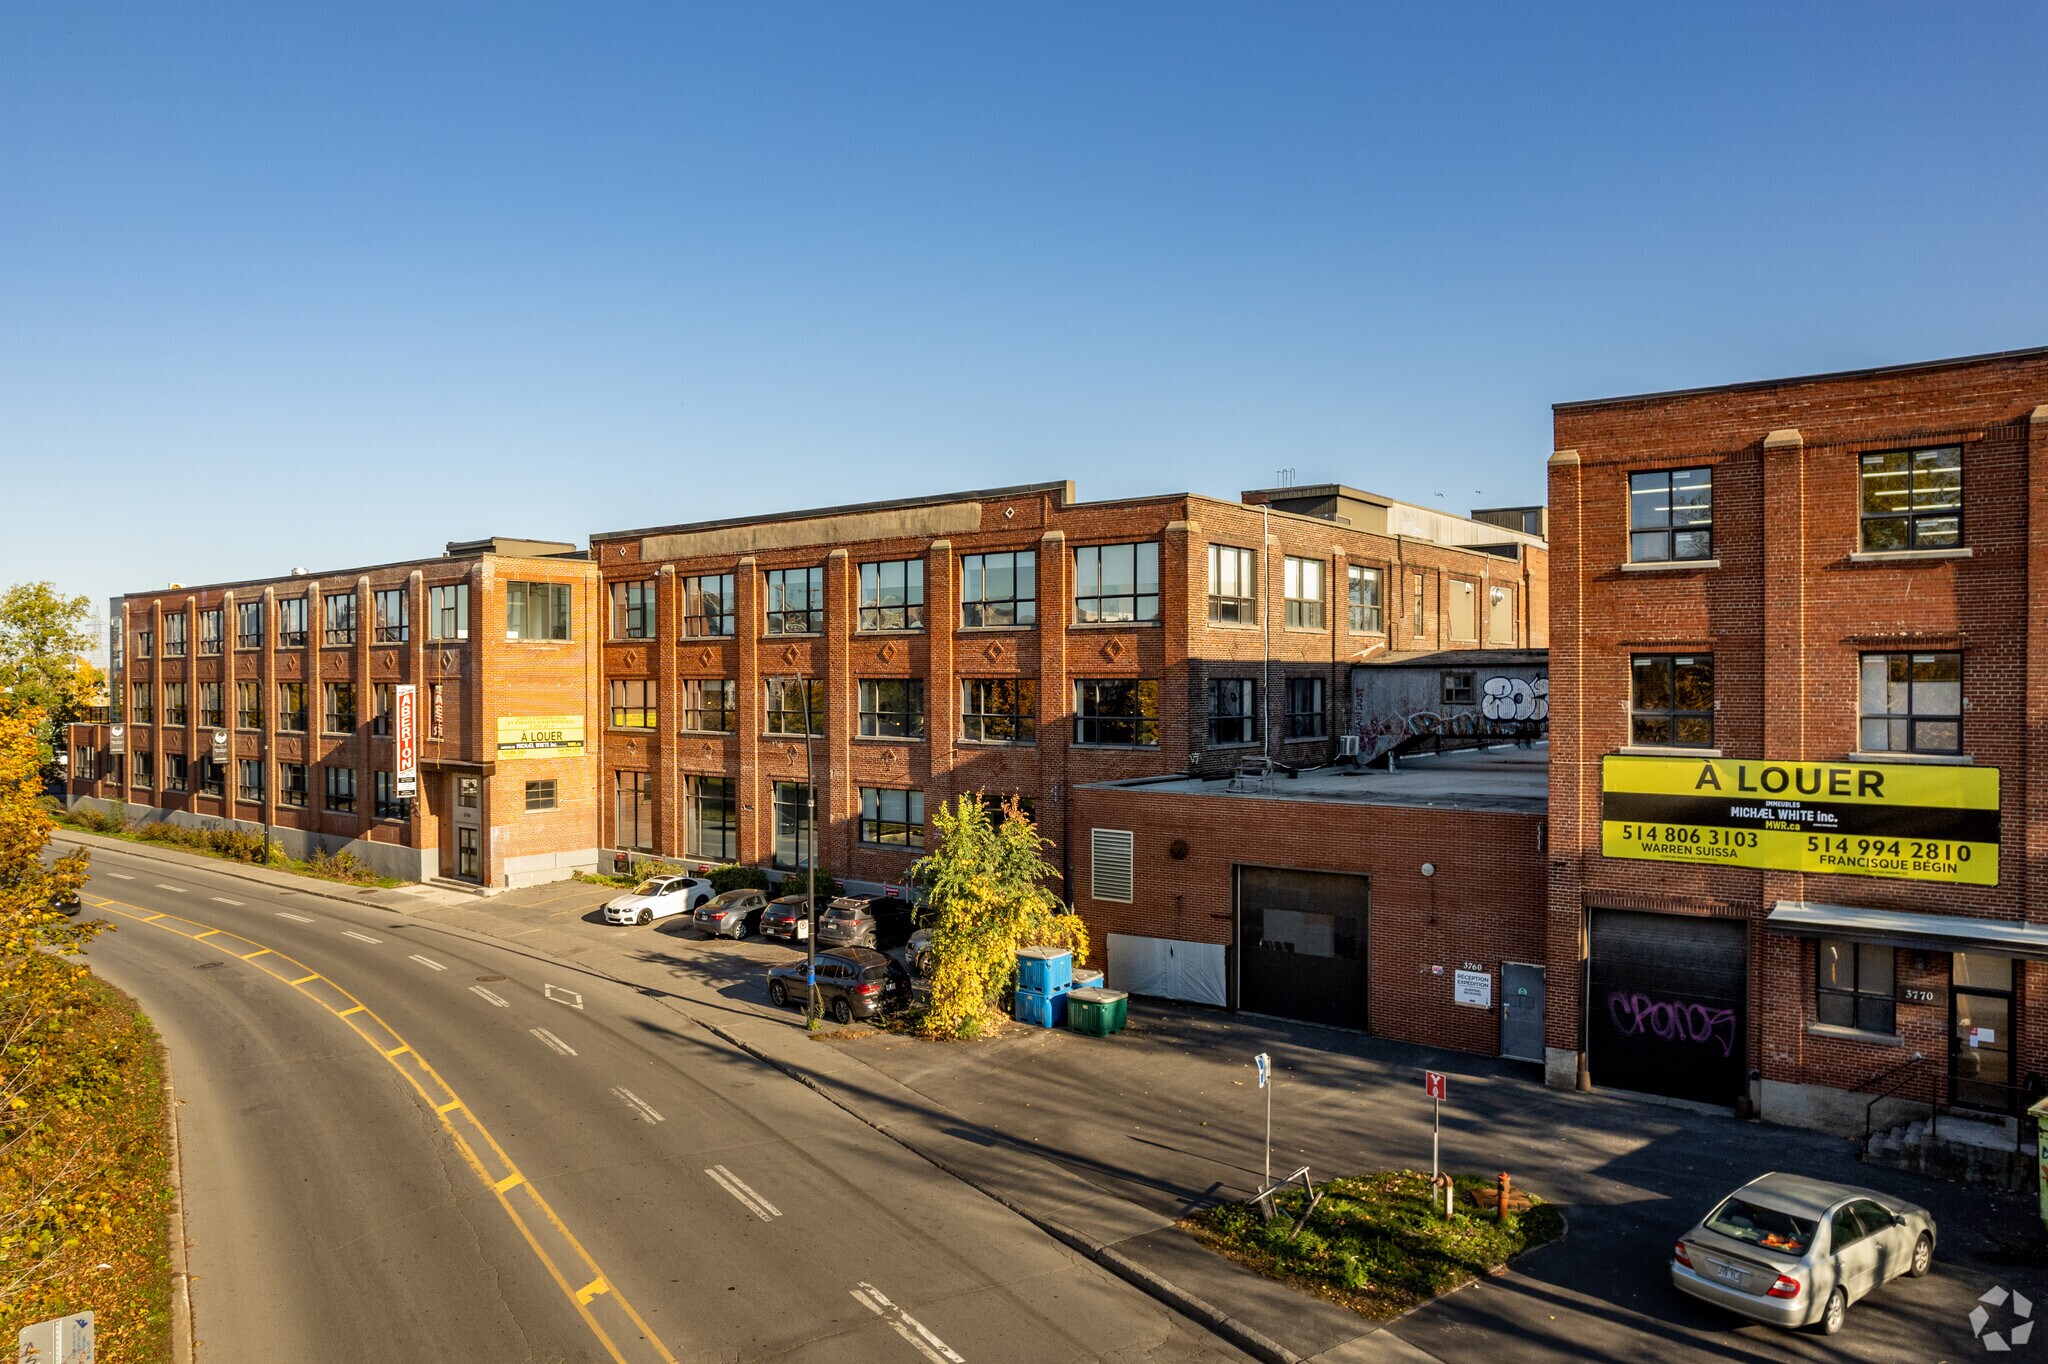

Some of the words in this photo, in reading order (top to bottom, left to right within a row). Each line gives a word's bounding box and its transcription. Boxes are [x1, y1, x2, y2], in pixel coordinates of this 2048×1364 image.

[401, 694, 412, 771] ABERTON
[521, 730, 528, 741] À
[531, 731, 563, 742] LOUER
[1695, 759, 1722, 791] À
[1739, 766, 1885, 799] LOUER
[1765, 800, 1800, 808] IMMEUBLES
[1778, 809, 1814, 821] WHITE
[1816, 810, 1838, 823] inc.
[1765, 820, 1800, 831] MWR.ca
[1622, 824, 1660, 842] 514
[1665, 827, 1700, 844] 806
[1709, 830, 1758, 848] 3103
[1642, 842, 1692, 855] WARREN
[1695, 846, 1738, 859] SUISSA
[1807, 836, 1848, 854] 514
[1858, 839, 1900, 857] 994
[1910, 842, 1971, 862] 2810
[1819, 854, 1908, 871] FRANCISQUE
[1913, 859, 1958, 874] BÉGIN
[1463, 961, 1482, 971] 3760
[1905, 989, 1934, 1001] 3770
